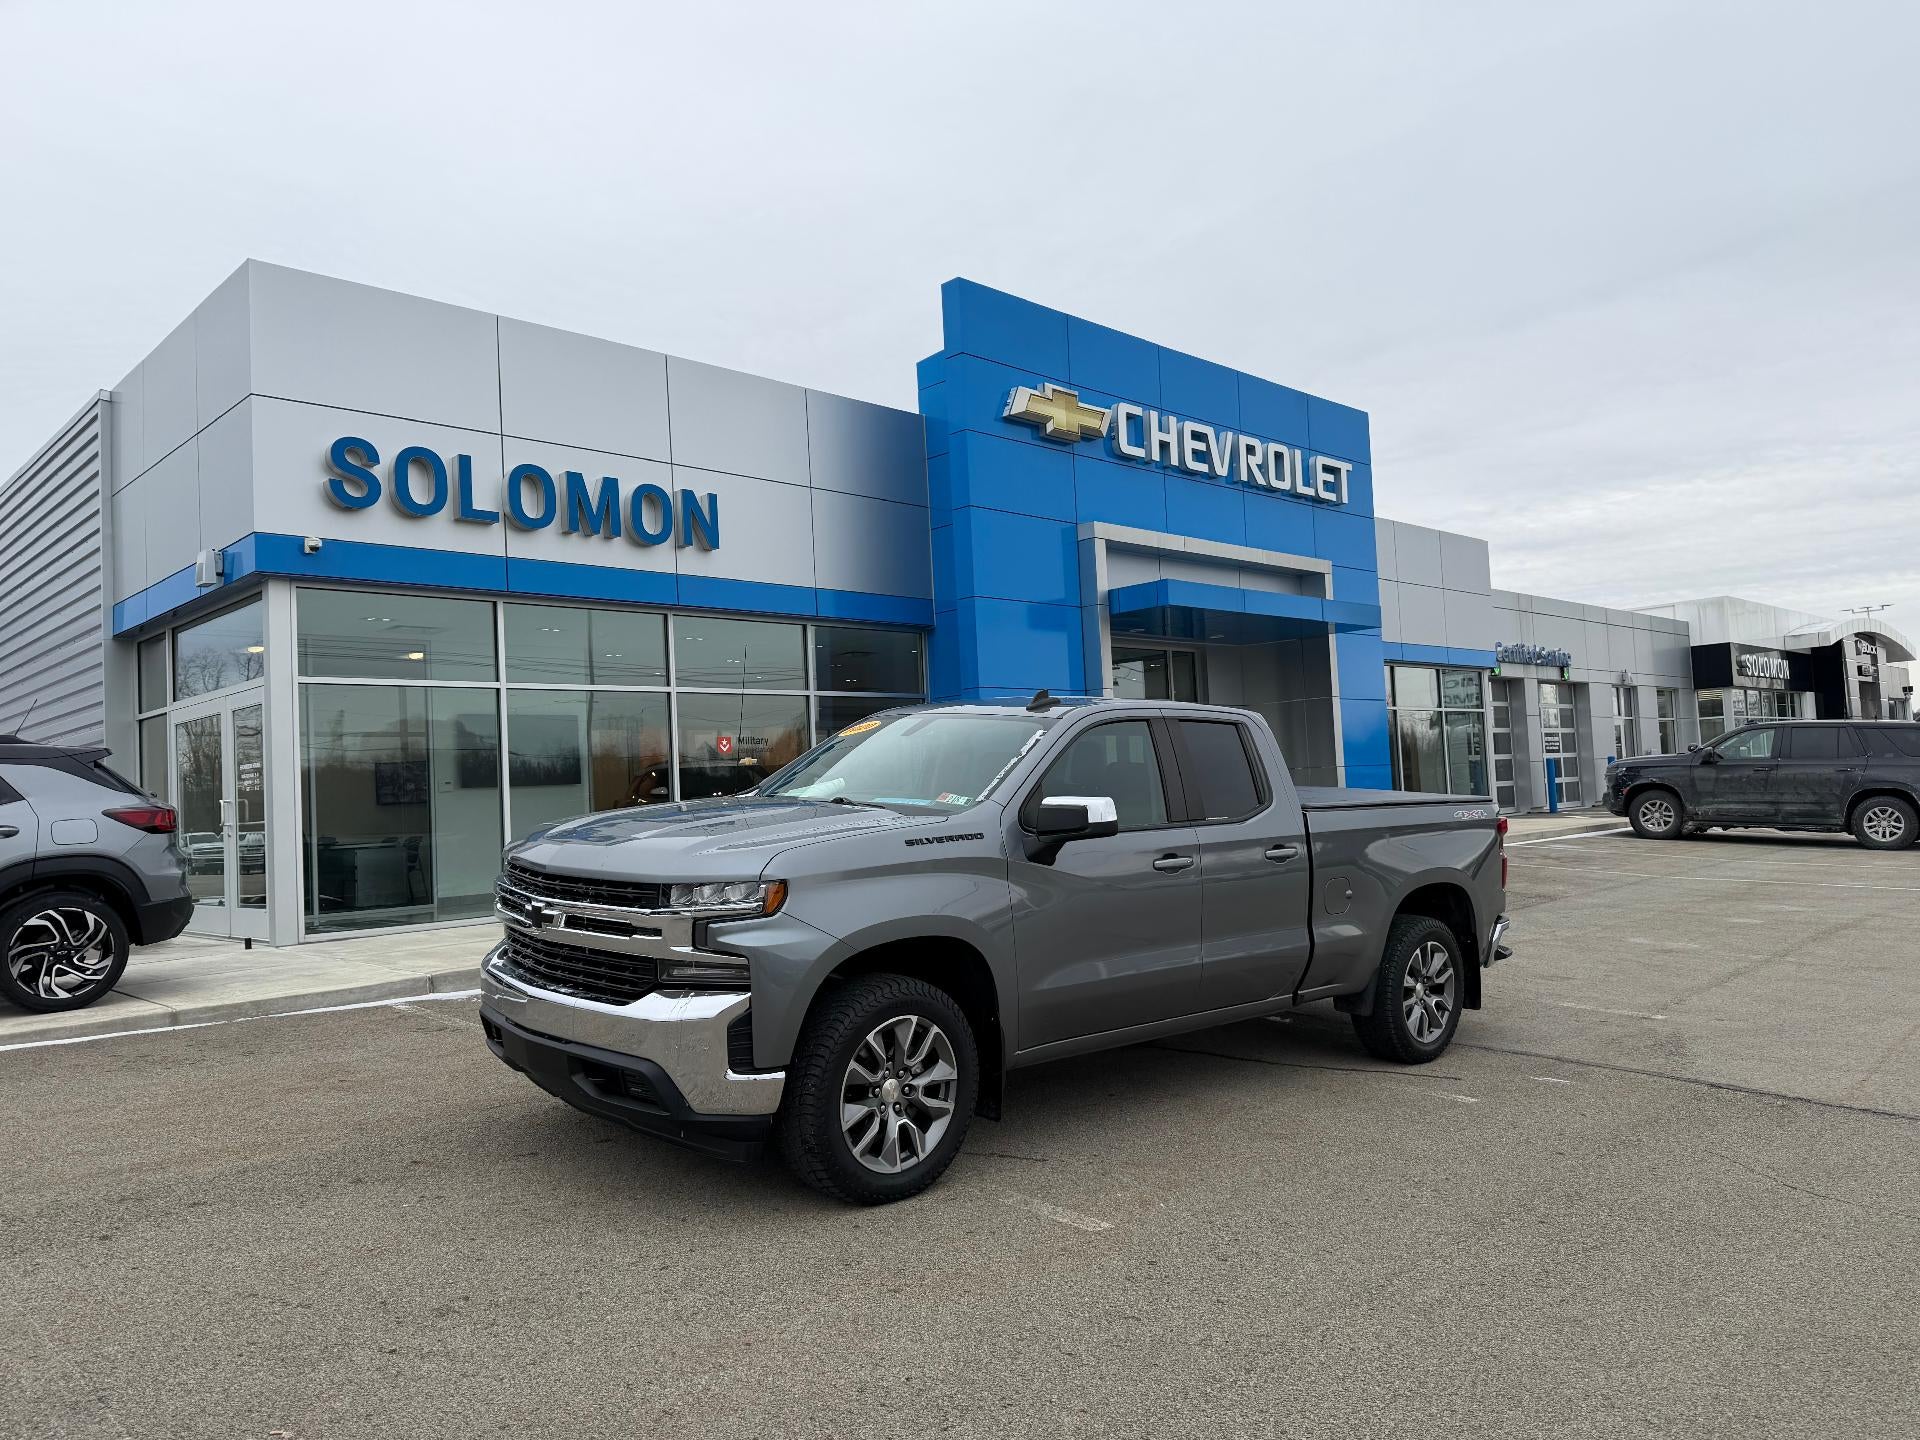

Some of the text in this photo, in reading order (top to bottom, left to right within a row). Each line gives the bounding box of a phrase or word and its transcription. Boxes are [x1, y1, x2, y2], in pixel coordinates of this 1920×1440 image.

[1111, 402, 1353, 505] CHEVROLET
[322, 436, 720, 551] SOLOMON
[1741, 654, 1790, 680] SOLOMON
[738, 735, 769, 747] Military
[904, 832, 985, 847] SILVERADO
